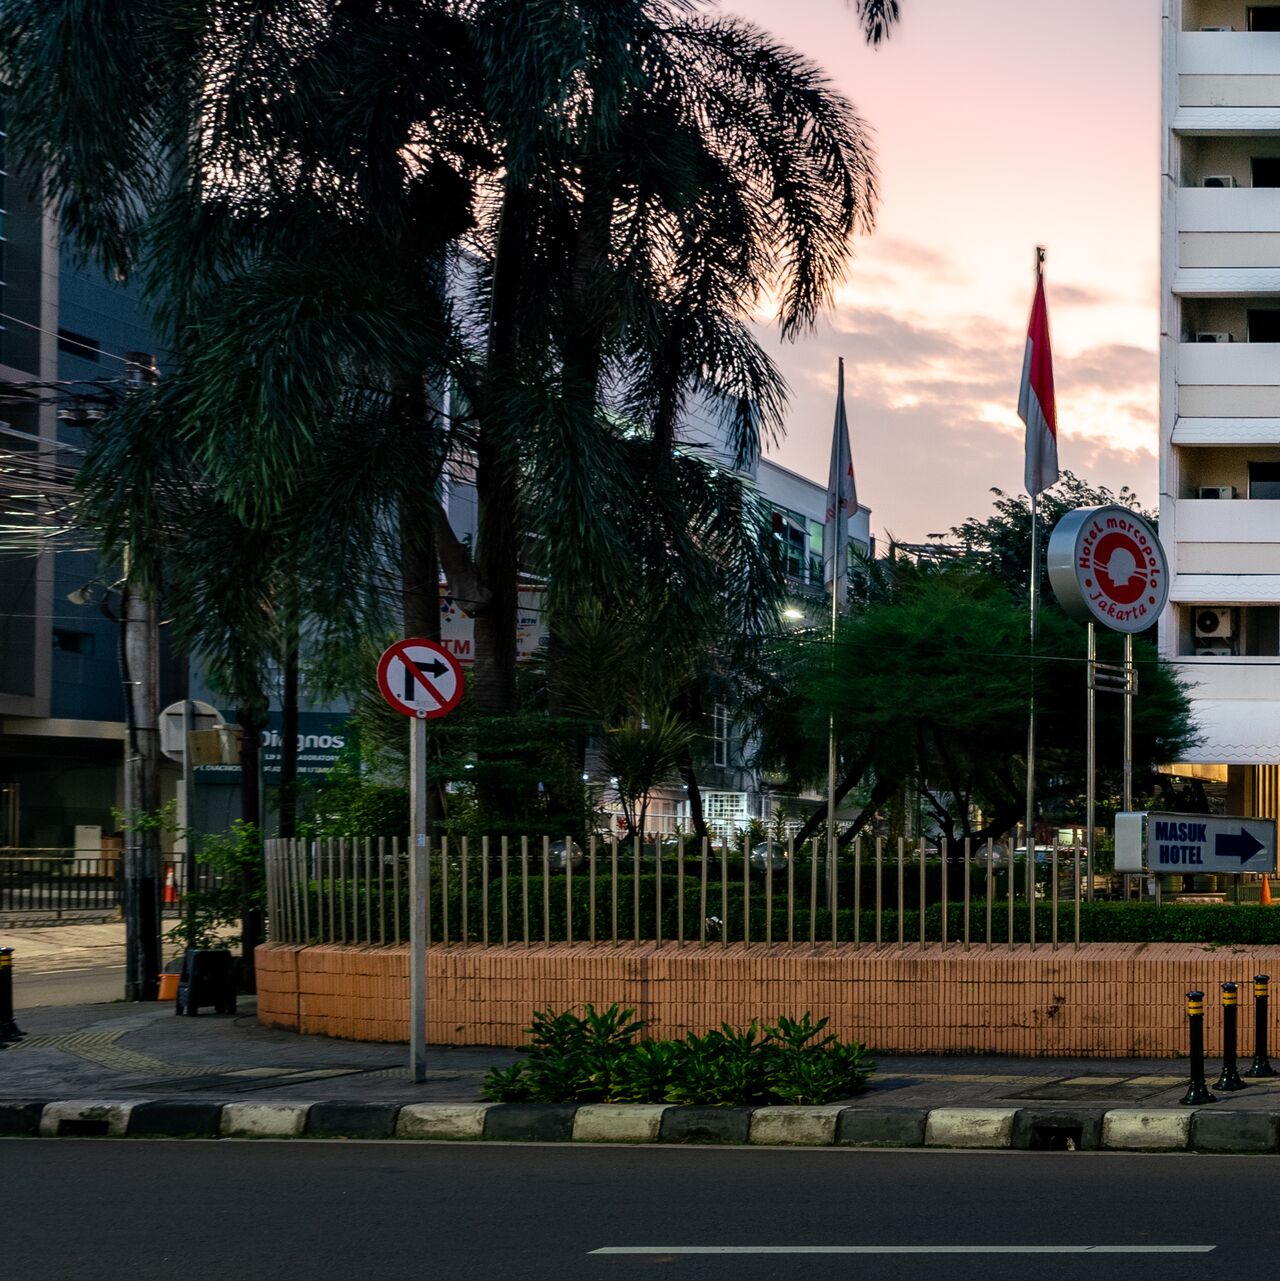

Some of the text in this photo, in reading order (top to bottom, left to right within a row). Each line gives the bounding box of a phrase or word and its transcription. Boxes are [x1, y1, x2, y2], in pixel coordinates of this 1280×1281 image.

[1089, 591, 1147, 621] Jakarta
[1155, 822, 1207, 842] MASUK
[1159, 845, 1203, 865] HOTEL
